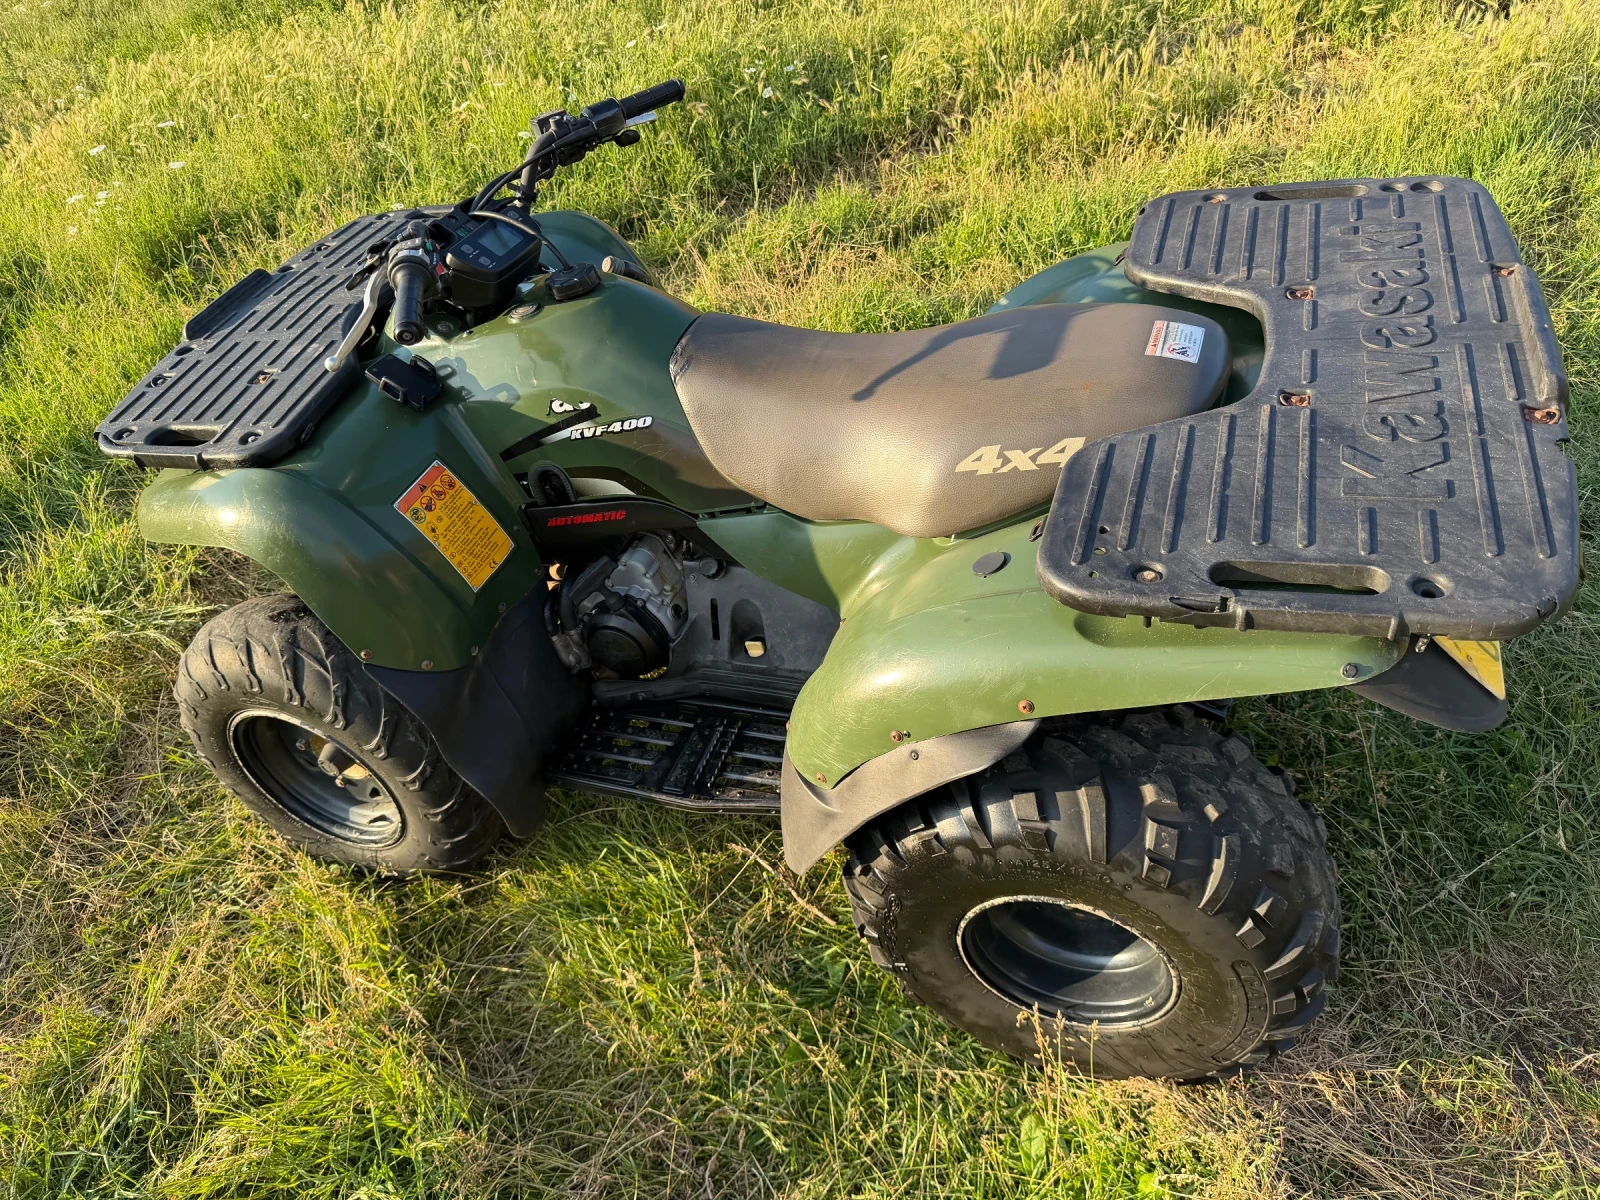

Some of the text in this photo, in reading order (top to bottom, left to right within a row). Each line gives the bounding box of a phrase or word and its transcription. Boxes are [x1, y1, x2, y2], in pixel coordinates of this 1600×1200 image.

[1338, 222, 1453, 501] Kawasaki
[570, 416, 652, 440] KVF400
[955, 436, 1087, 475] 4x4
[547, 510, 627, 527] AUTOMATIC
